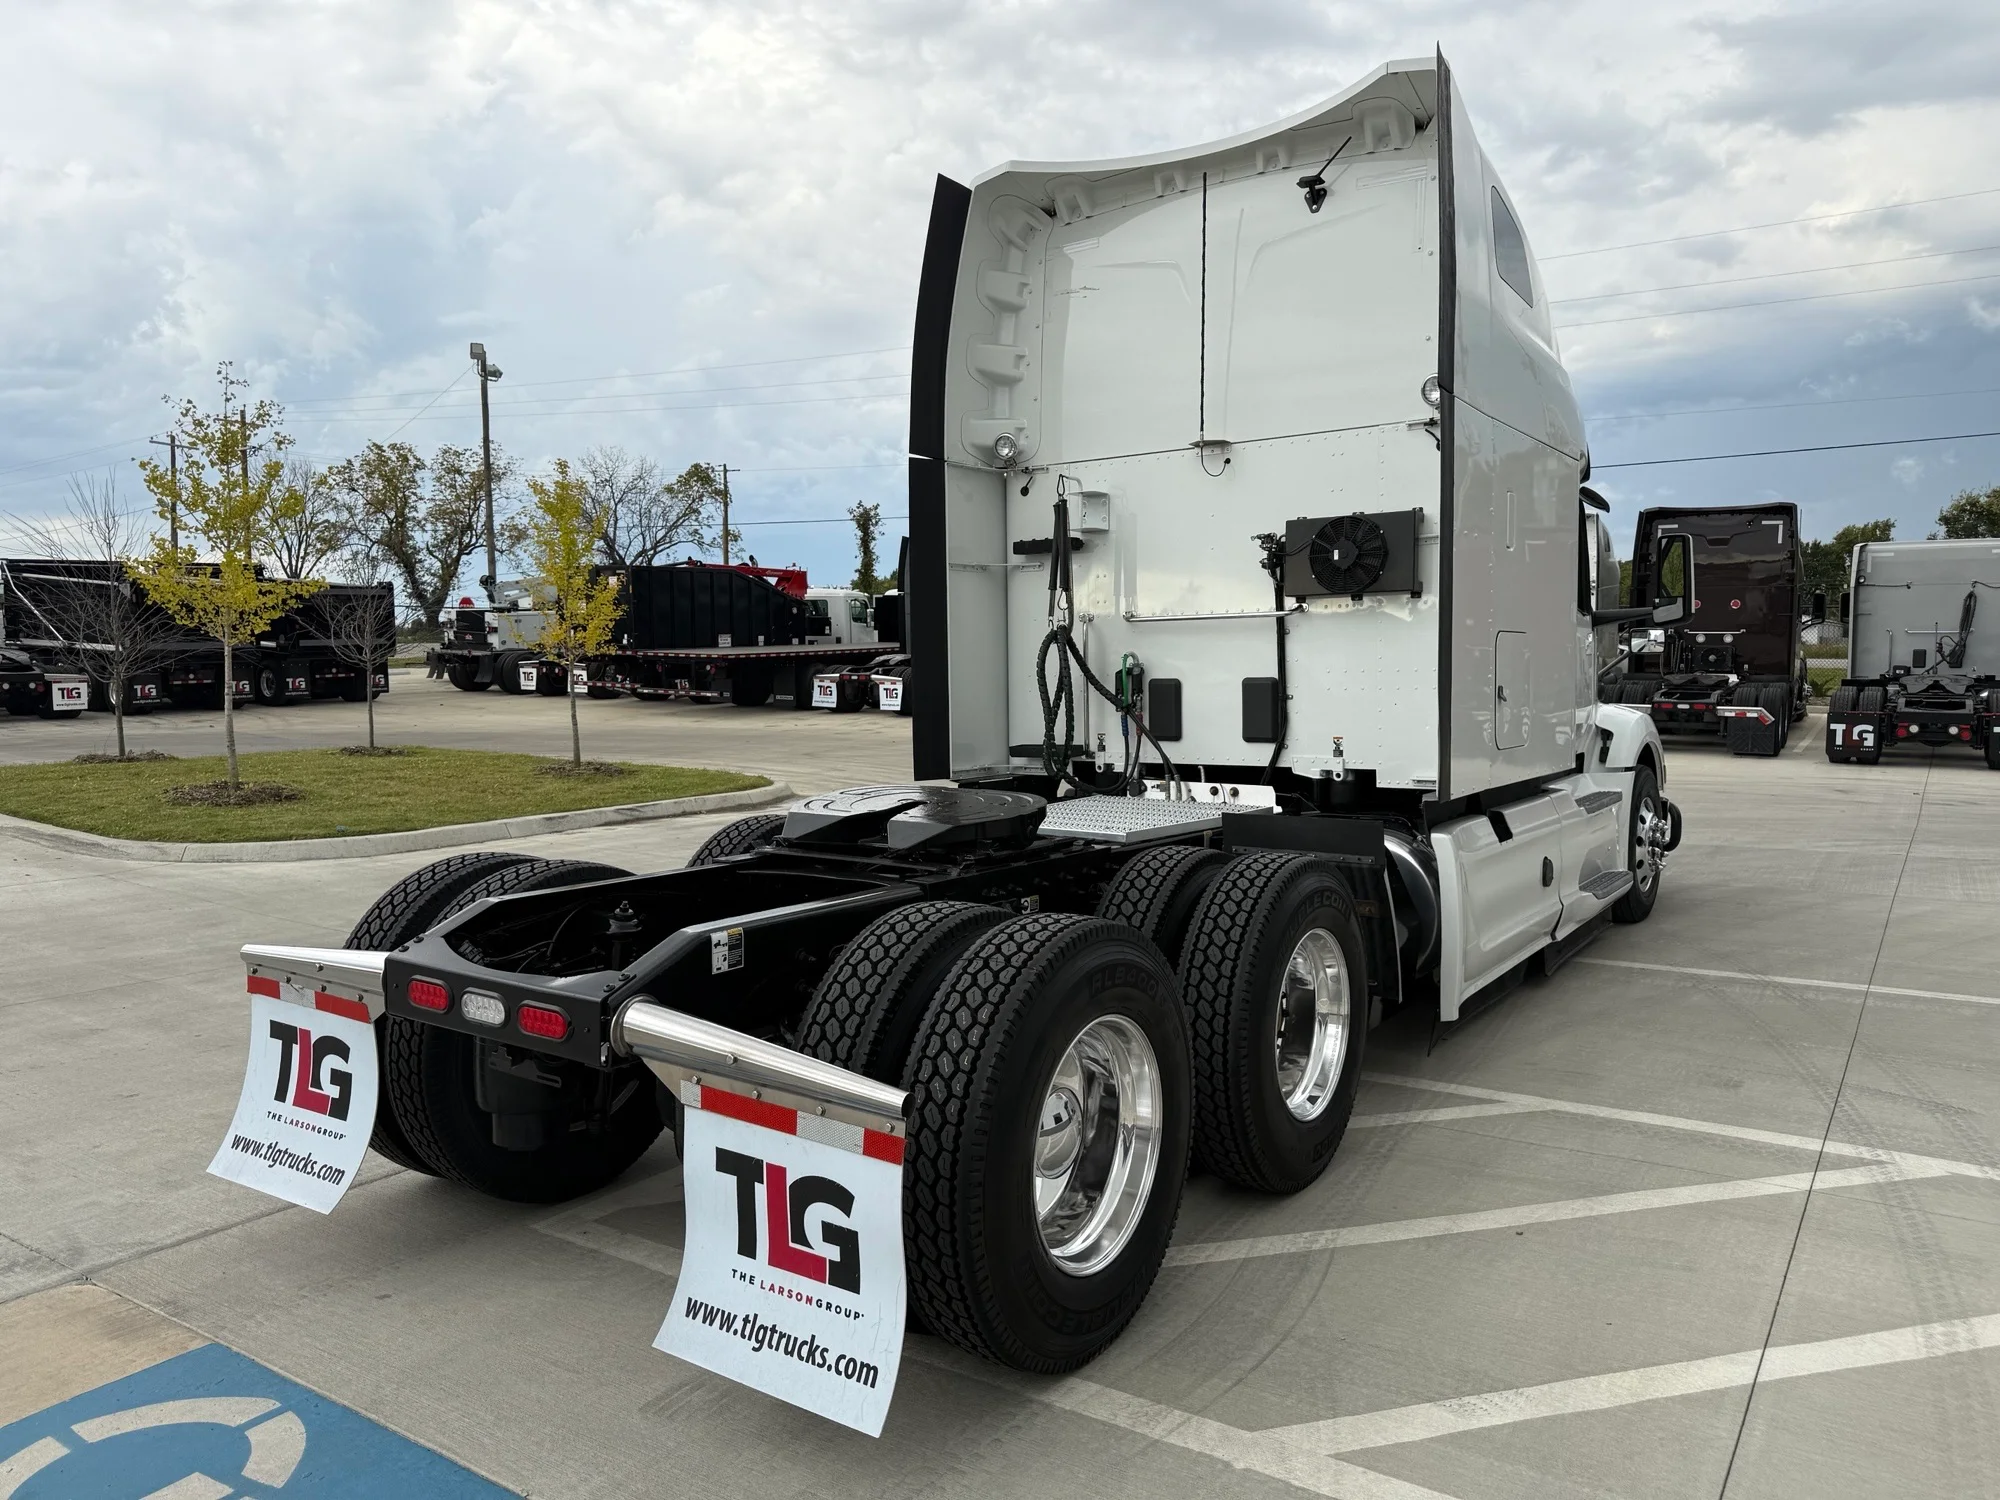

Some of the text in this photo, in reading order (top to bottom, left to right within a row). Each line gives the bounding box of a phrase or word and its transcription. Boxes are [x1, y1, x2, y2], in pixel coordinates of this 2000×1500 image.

[286, 677, 306, 689] TLG
[818, 684, 833, 697] TLG
[58, 686, 82, 700] TLG
[134, 684, 157, 699] TLG
[883, 687, 899, 699] TLG
[1830, 723, 1875, 746] TLG
[269, 1019, 352, 1121] TLG
[267, 1110, 283, 1122] THE
[231, 1133, 346, 1187] www.tlgtrucks.com
[715, 1146, 861, 1295] TLG
[731, 1268, 756, 1285] THE
[684, 1296, 879, 1389] www.tlgtrucks.com
